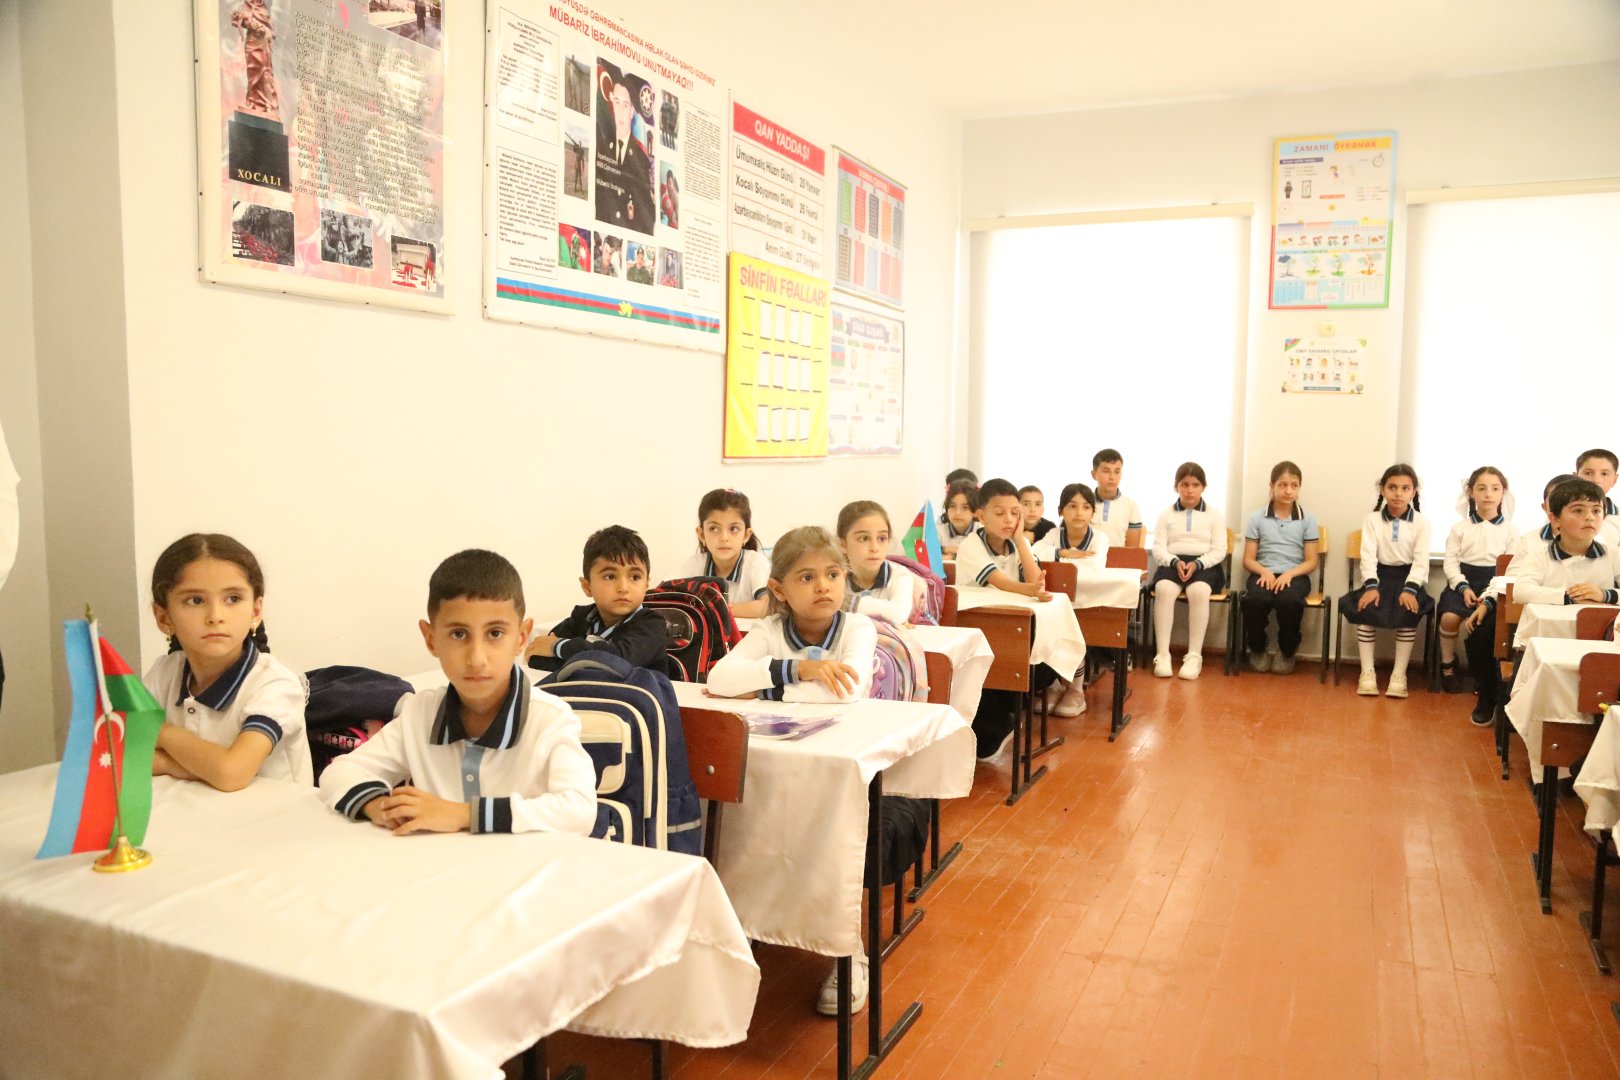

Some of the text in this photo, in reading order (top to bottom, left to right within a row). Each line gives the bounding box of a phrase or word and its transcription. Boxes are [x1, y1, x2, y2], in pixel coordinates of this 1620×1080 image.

[549, 5, 590, 37] MÜBARİZ
[592, 25, 641, 64] İBRAHİMOVU
[643, 55, 694, 92] UNUTMAYAQ!!!
[645, 41, 664, 58] HƏLAK
[665, 52, 679, 65] OLAN
[754, 119, 811, 162] QAN YADDAŞI
[1294, 143, 1329, 153] ZAMANI
[237, 168, 281, 187] XOCALI
[735, 173, 754, 191] Xocalı
[740, 264, 828, 308] SİNFİN FƏALLARI
